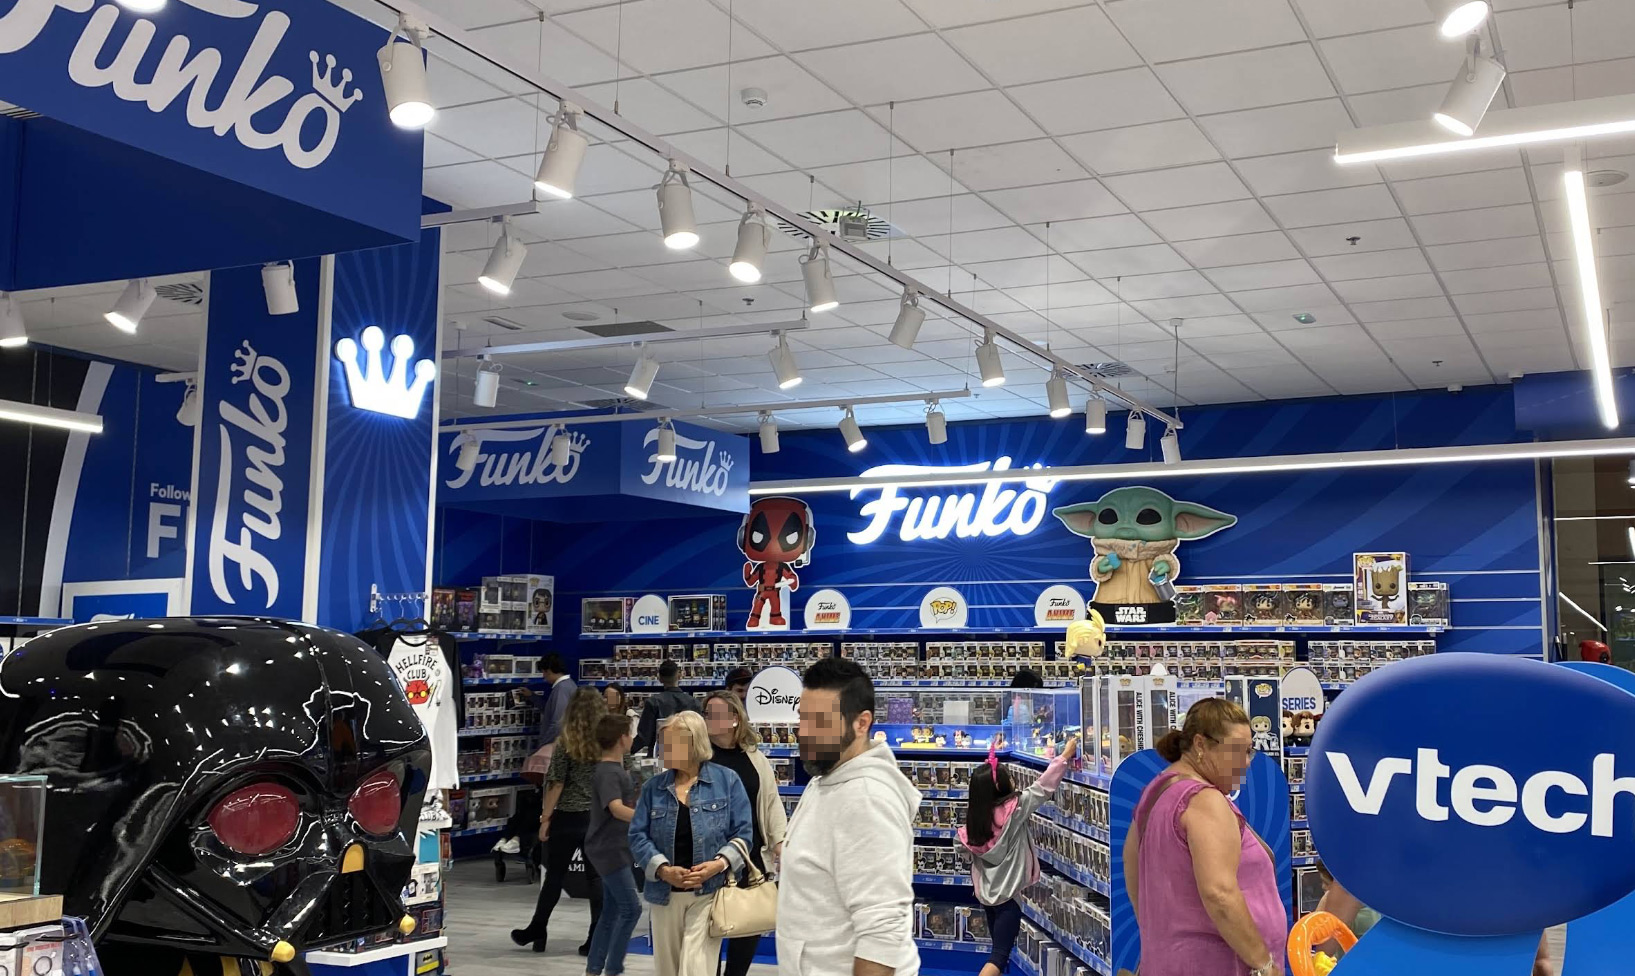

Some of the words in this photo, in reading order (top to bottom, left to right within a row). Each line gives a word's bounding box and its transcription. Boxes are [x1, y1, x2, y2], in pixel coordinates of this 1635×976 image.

[446, 426, 582, 489] Funko
[641, 429, 731, 497] Funko
[209, 353, 291, 609] Funko
[150, 482, 191, 501] Follow
[846, 456, 1050, 545] Funko
[147, 502, 190, 558] F
[930, 600, 957, 616] POP!
[1115, 606, 1146, 615] STAR
[638, 615, 659, 626] CINE
[1115, 614, 1147, 623] WARS
[395, 654, 438, 674] HELLFIRE
[407, 668, 427, 680] CLUB
[1282, 696, 1316, 711] SERIES
[1169, 709, 1177, 724] WITH
[1136, 724, 1145, 751] CHESHIR
[1325, 747, 1635, 838] vtech
